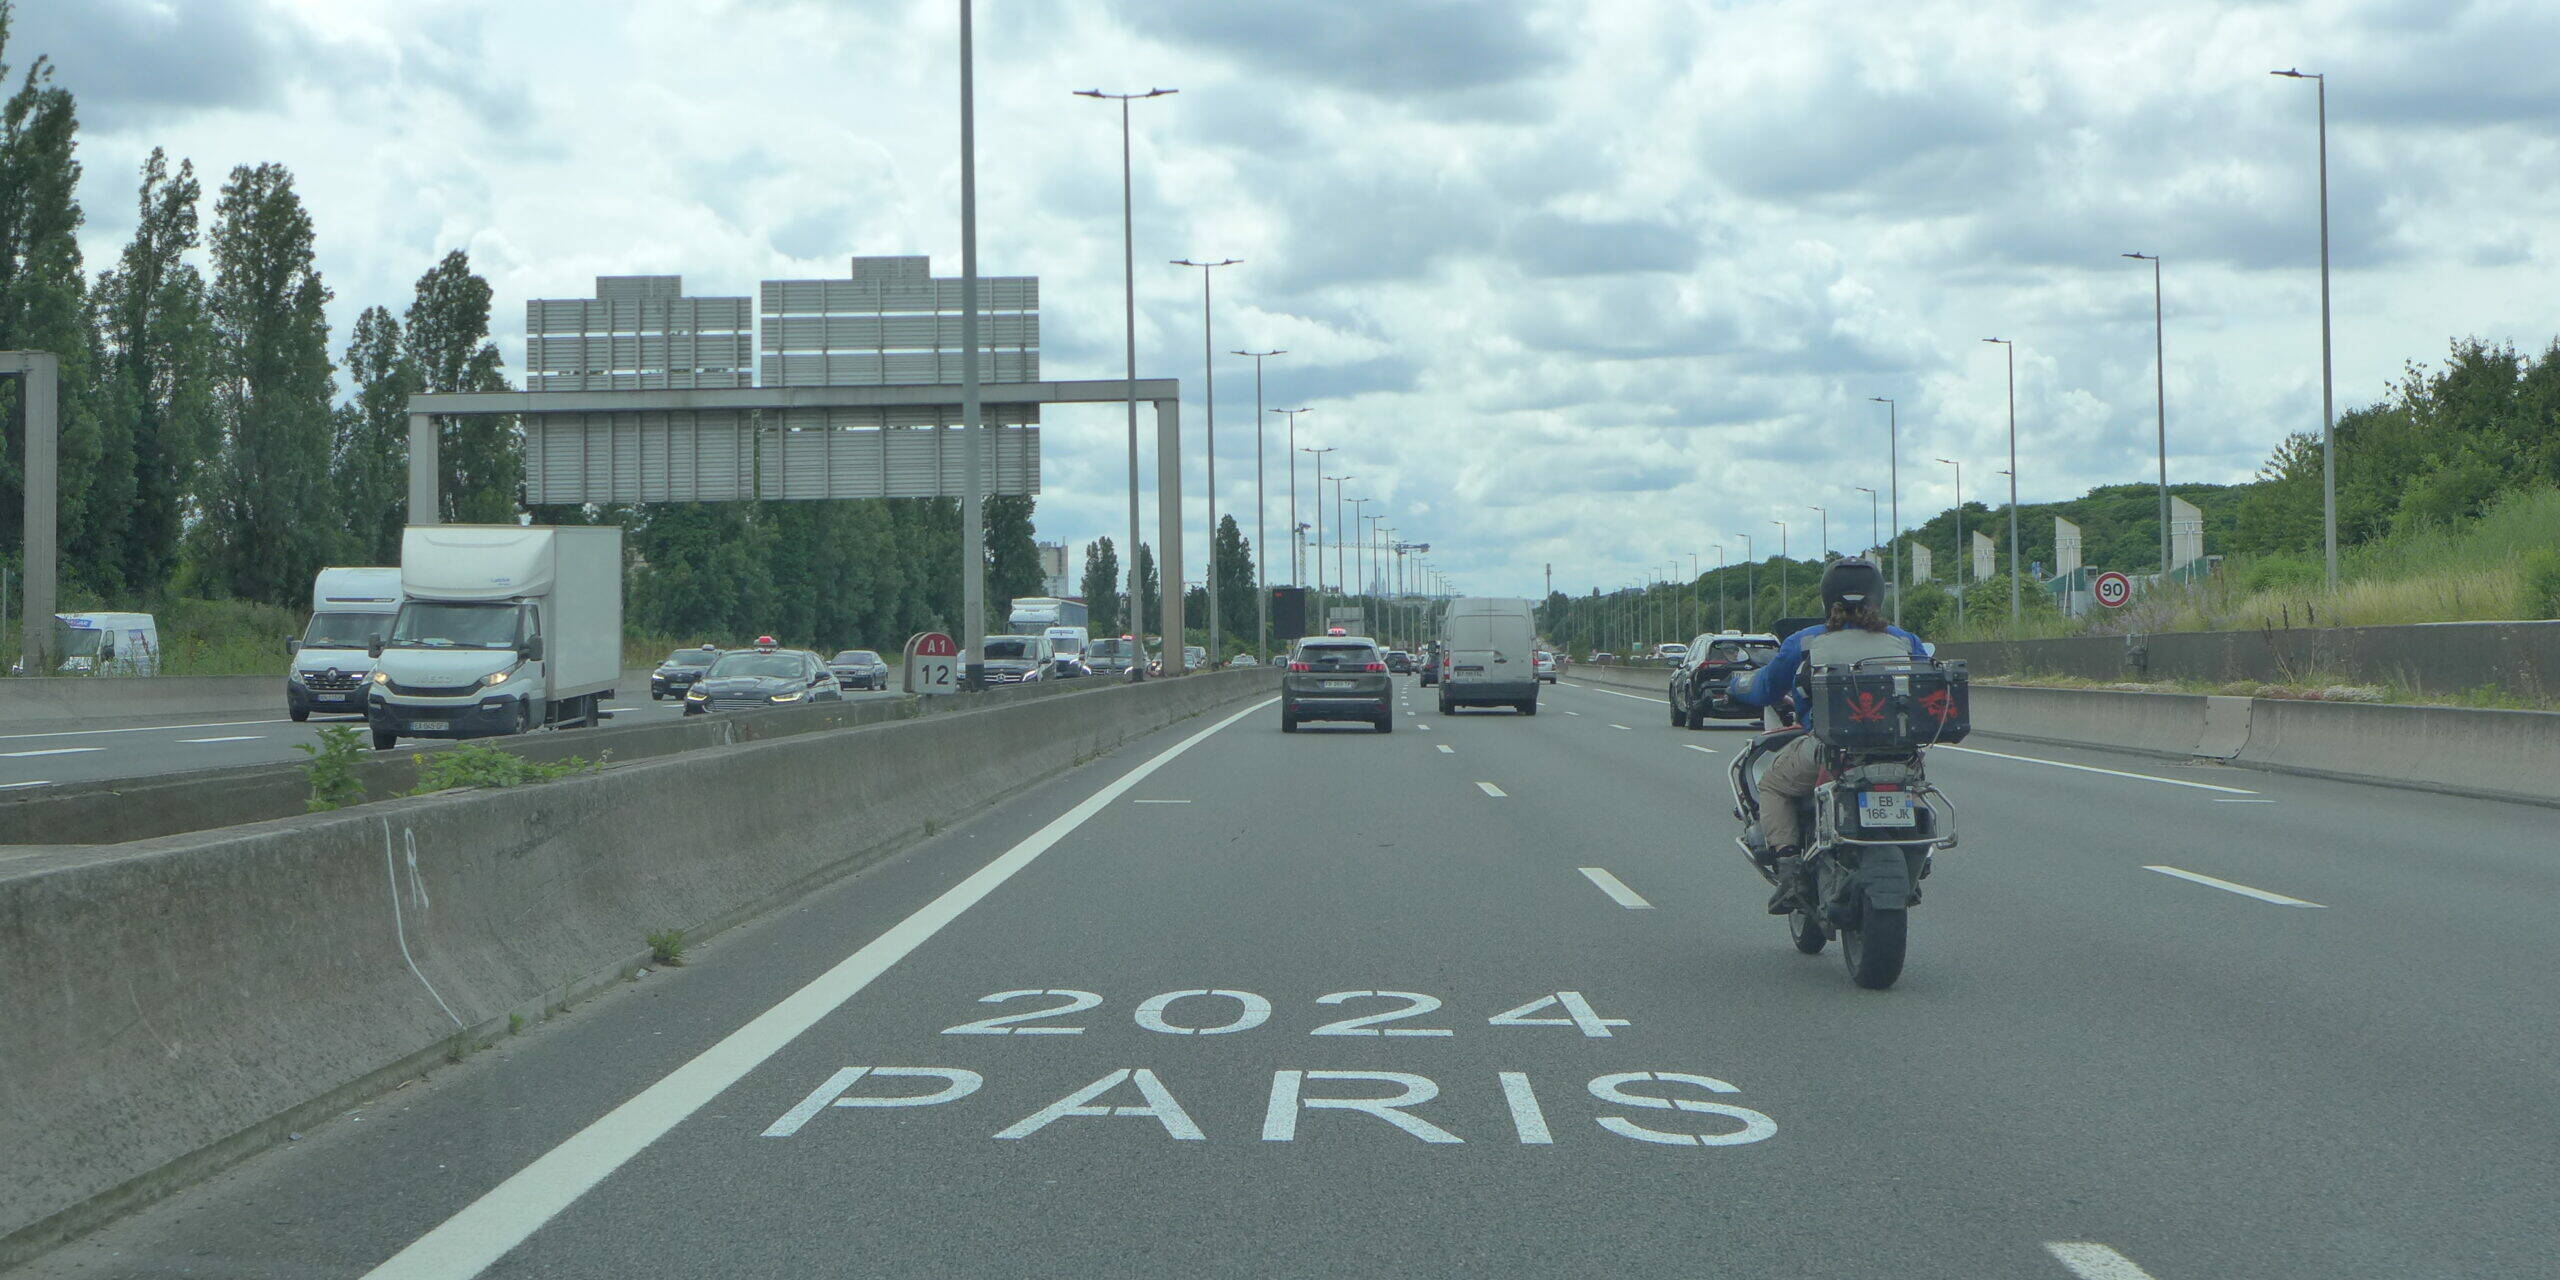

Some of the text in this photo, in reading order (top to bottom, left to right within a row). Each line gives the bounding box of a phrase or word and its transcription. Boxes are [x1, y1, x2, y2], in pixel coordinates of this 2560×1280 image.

[2102, 583, 2123, 596] 90
[922, 664, 949, 685] 12
[941, 988, 1632, 1038] 2024
[760, 1065, 1778, 1147] PARIS
